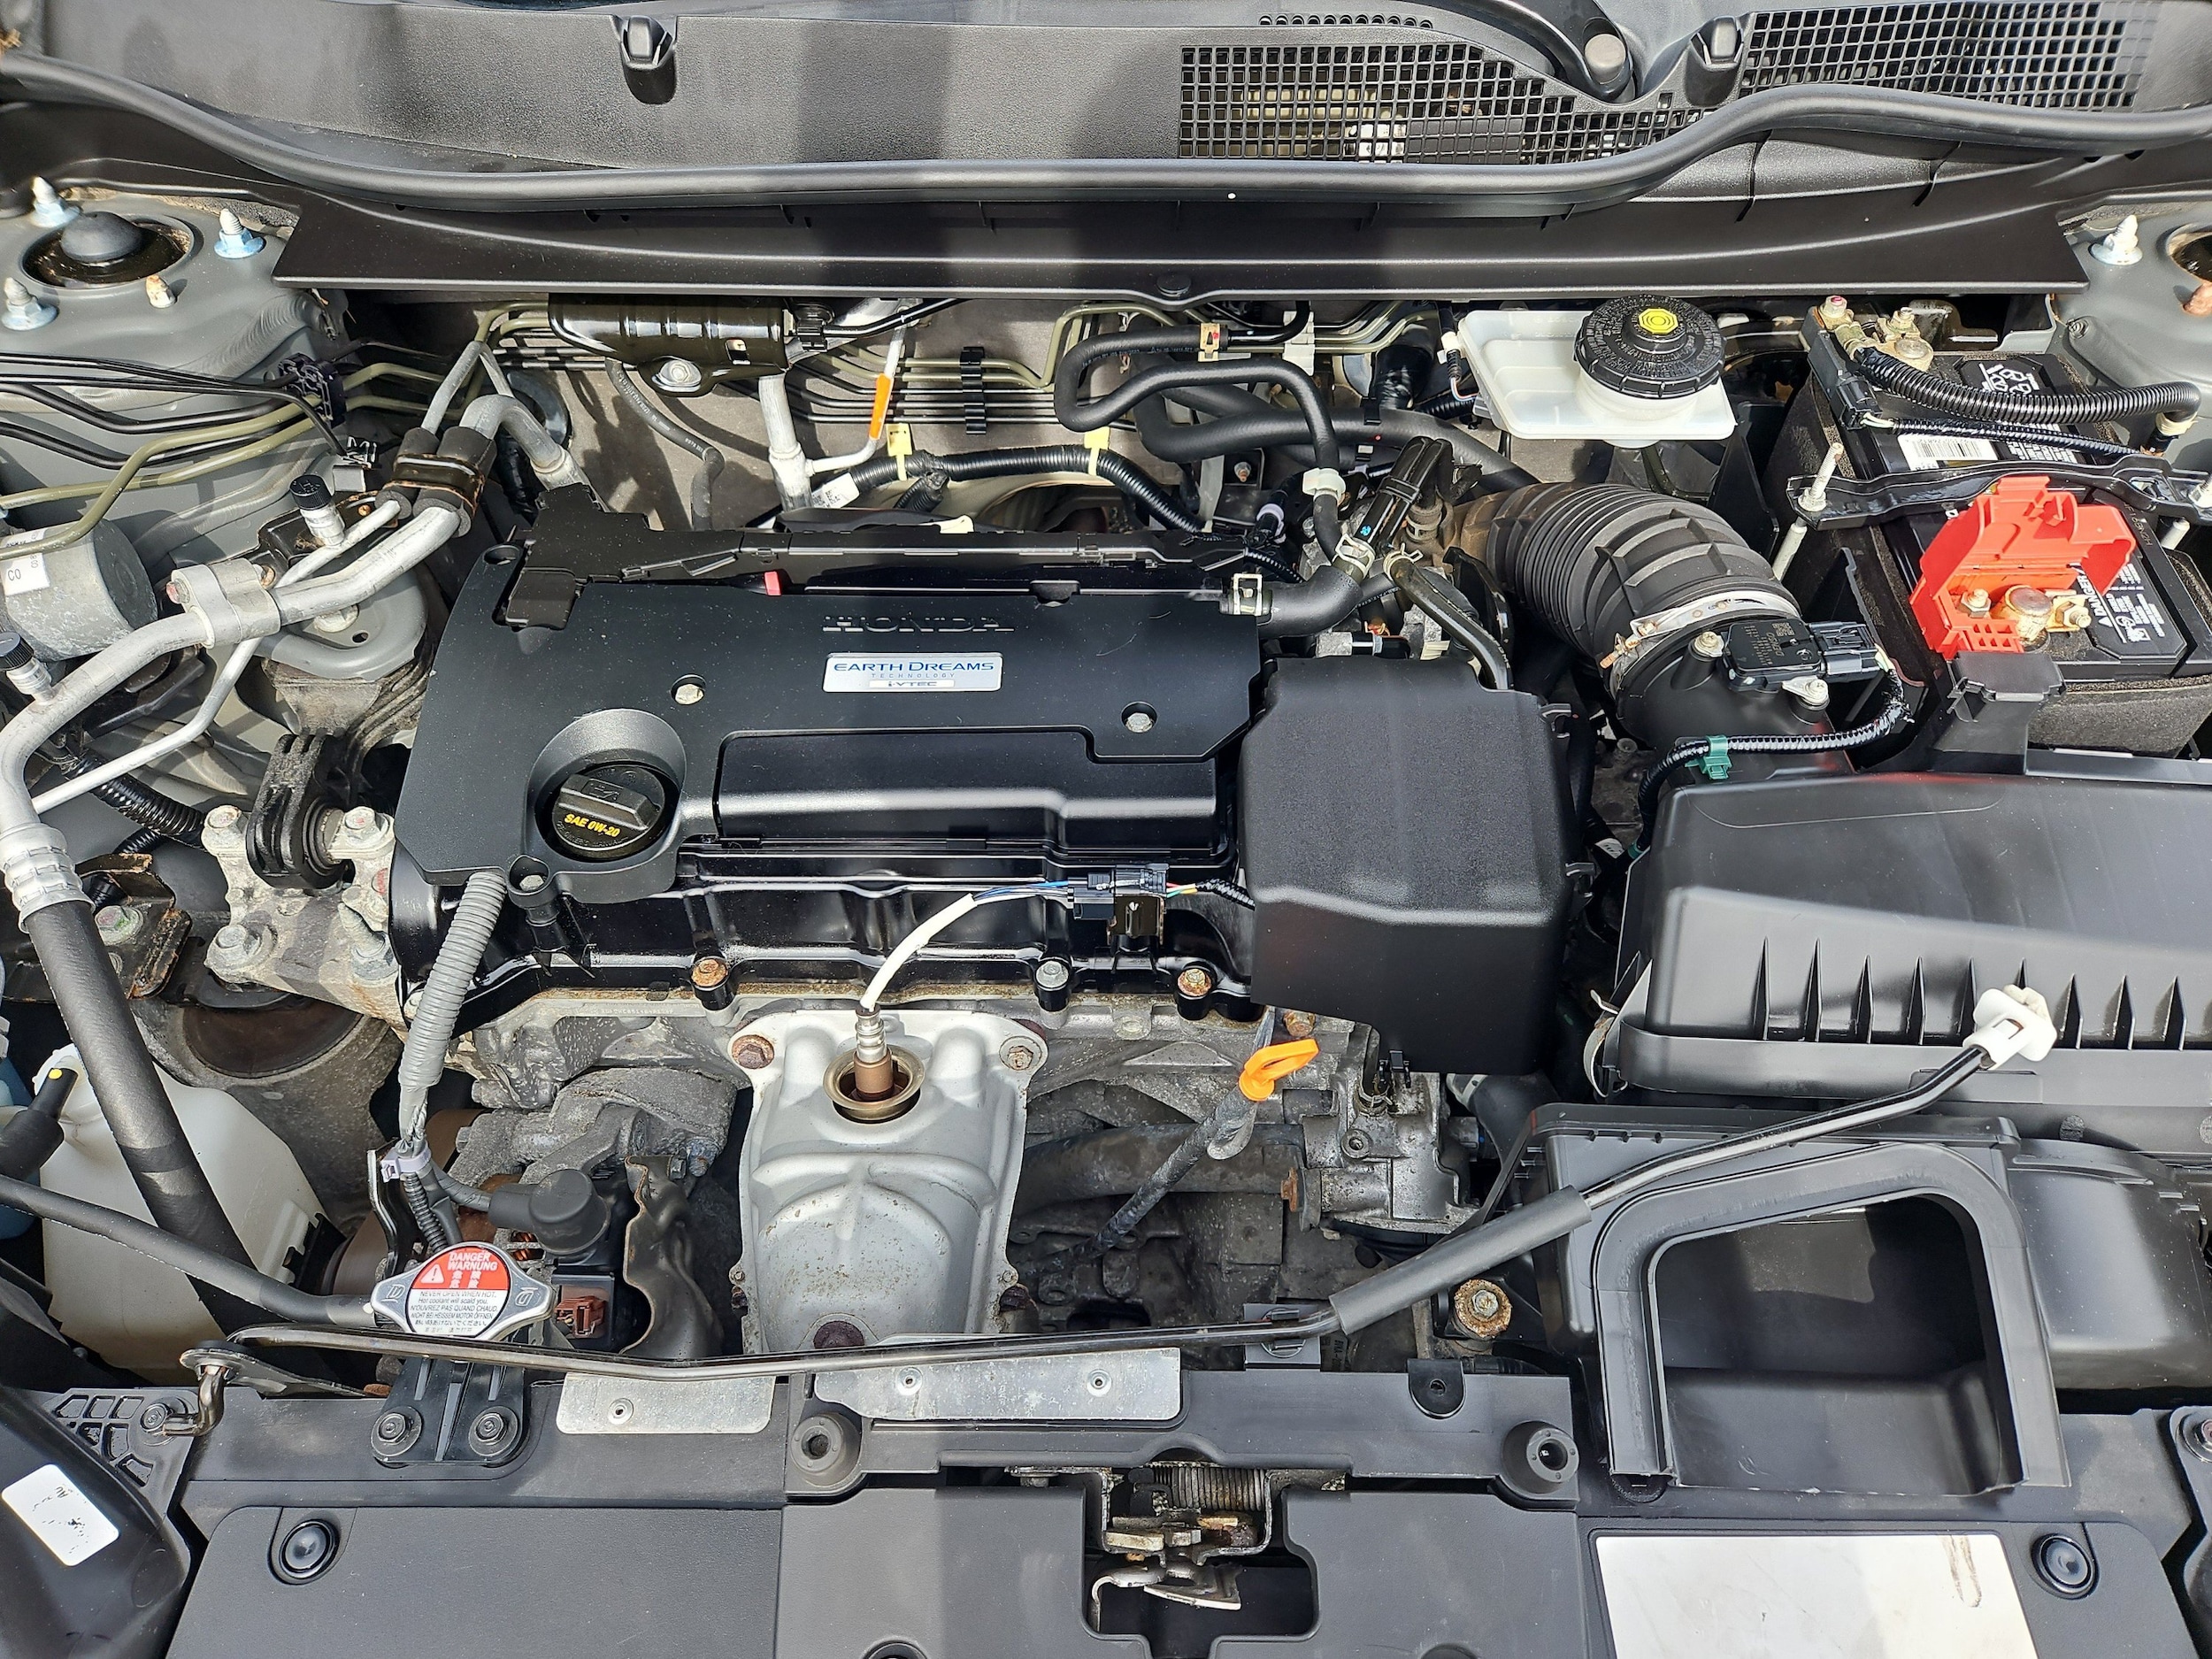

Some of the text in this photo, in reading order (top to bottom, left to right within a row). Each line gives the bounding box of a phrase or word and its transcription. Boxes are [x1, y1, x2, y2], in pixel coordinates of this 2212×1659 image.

[822, 616, 1015, 632] HONDA
[833, 661, 995, 672] EARTH DREAMS
[564, 813, 621, 838] SAE 0W-20
[449, 1251, 491, 1261] DANGER
[447, 1262, 498, 1271] WARNUNG
